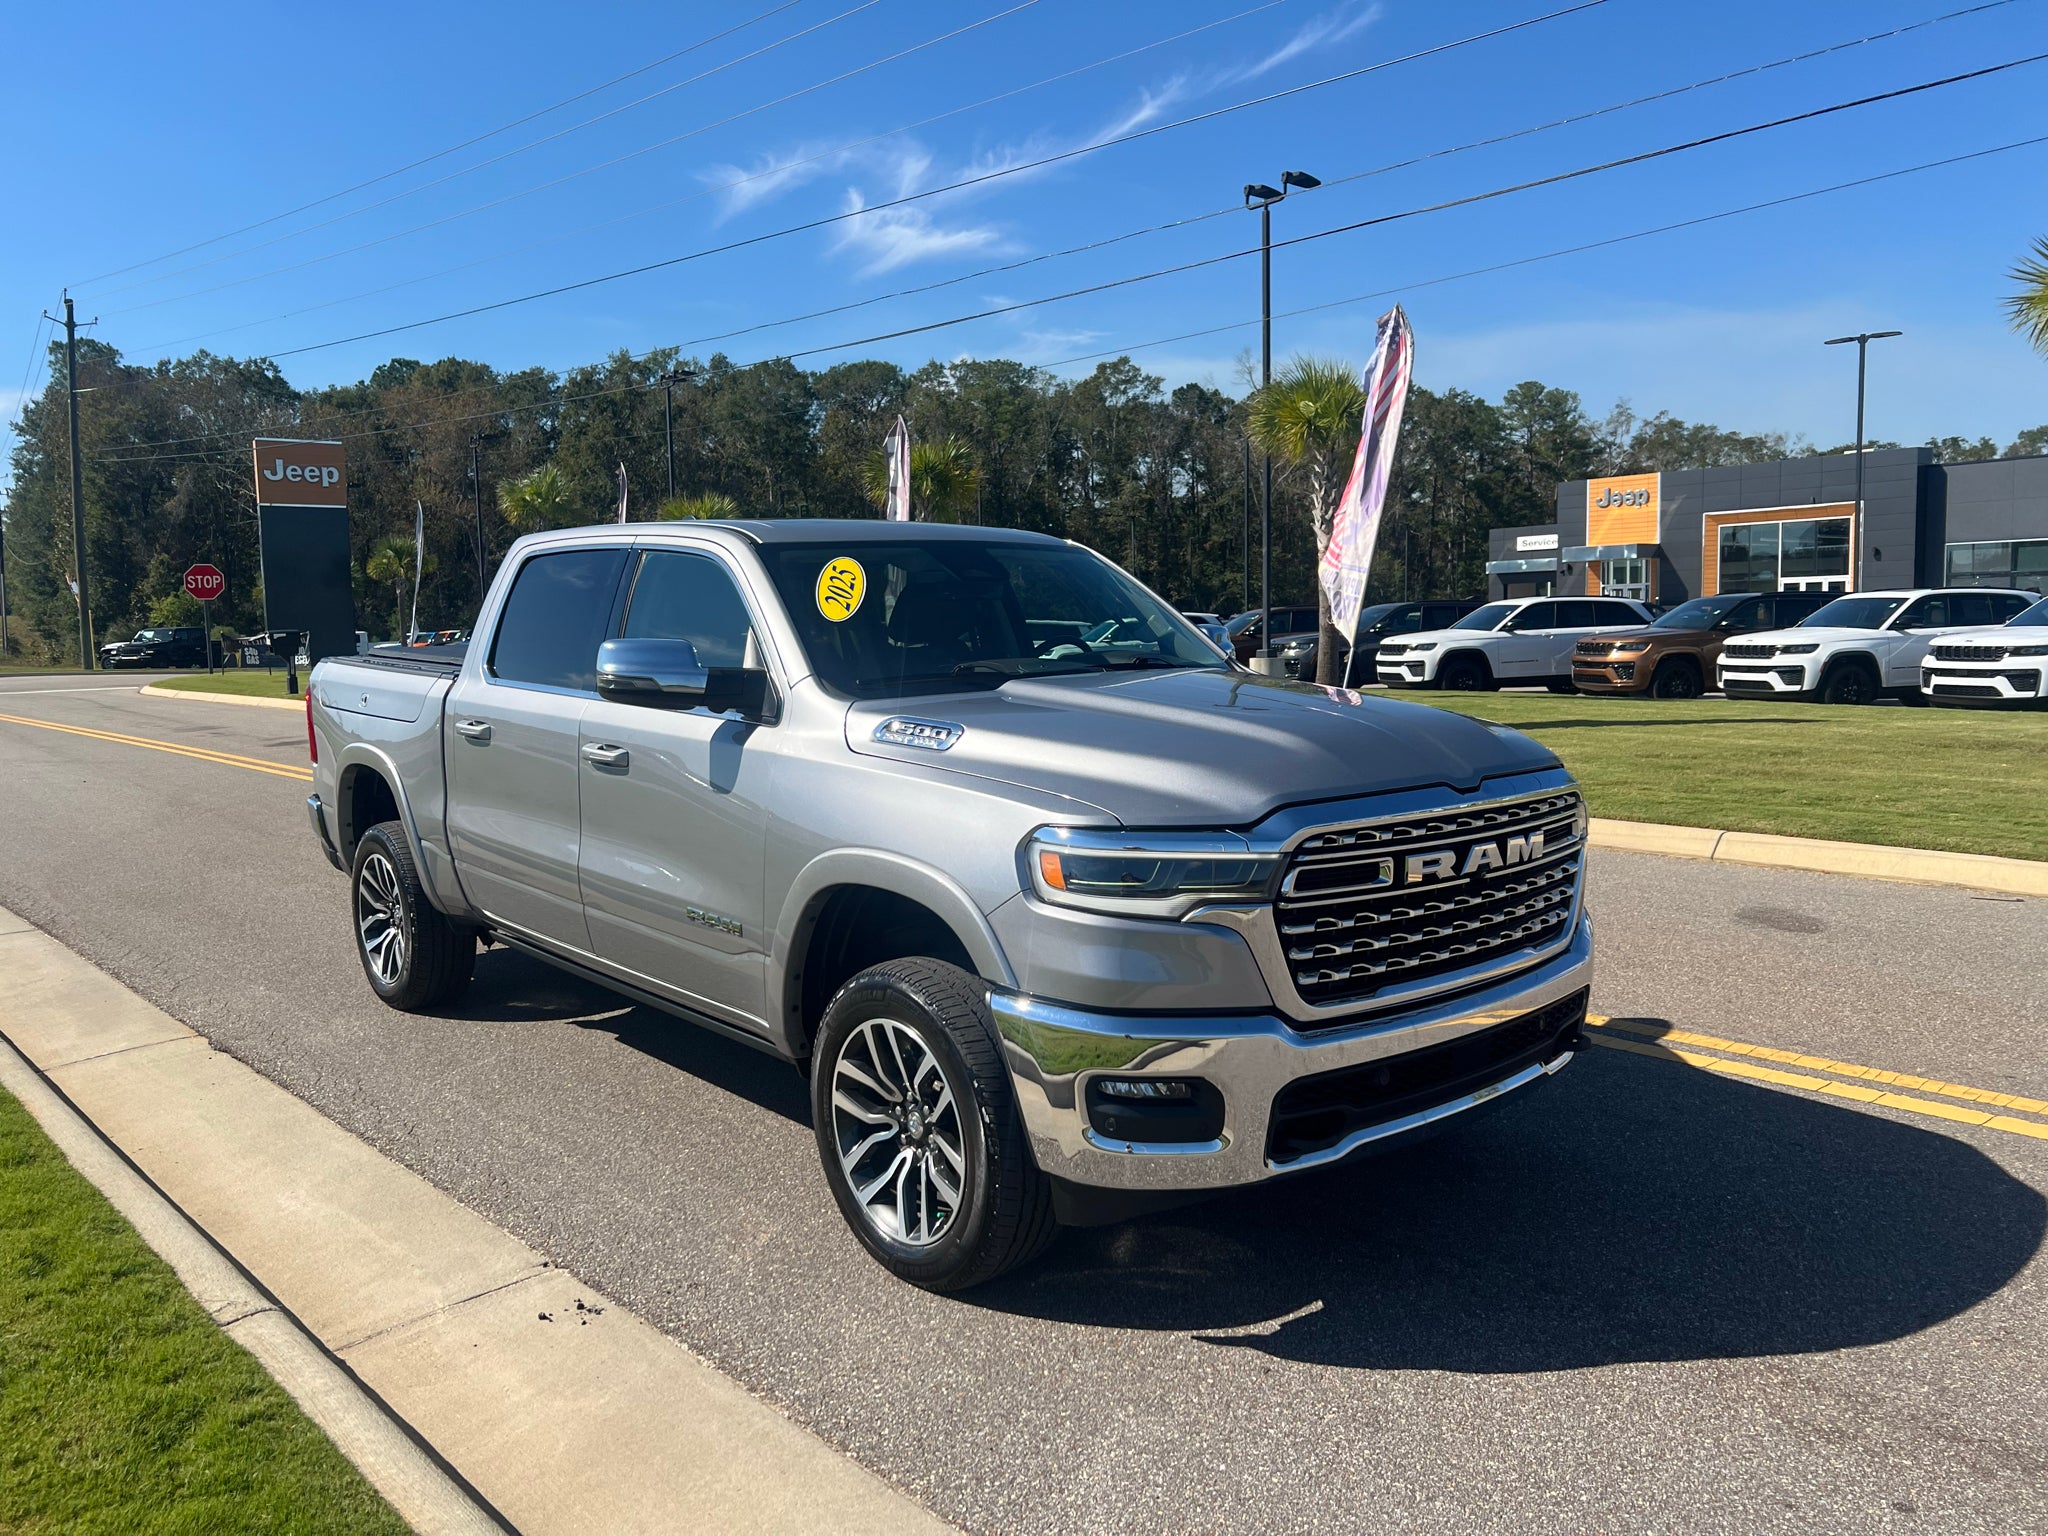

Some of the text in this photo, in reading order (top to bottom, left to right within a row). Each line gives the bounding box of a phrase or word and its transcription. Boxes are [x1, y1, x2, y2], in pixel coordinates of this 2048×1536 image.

[264, 458, 339, 487] Jeep
[1596, 488, 1649, 508] Jeep
[1522, 539, 1557, 547] Service
[187, 575, 221, 588] STOP
[825, 565, 857, 612] 2025
[1405, 830, 1544, 885] RAM
